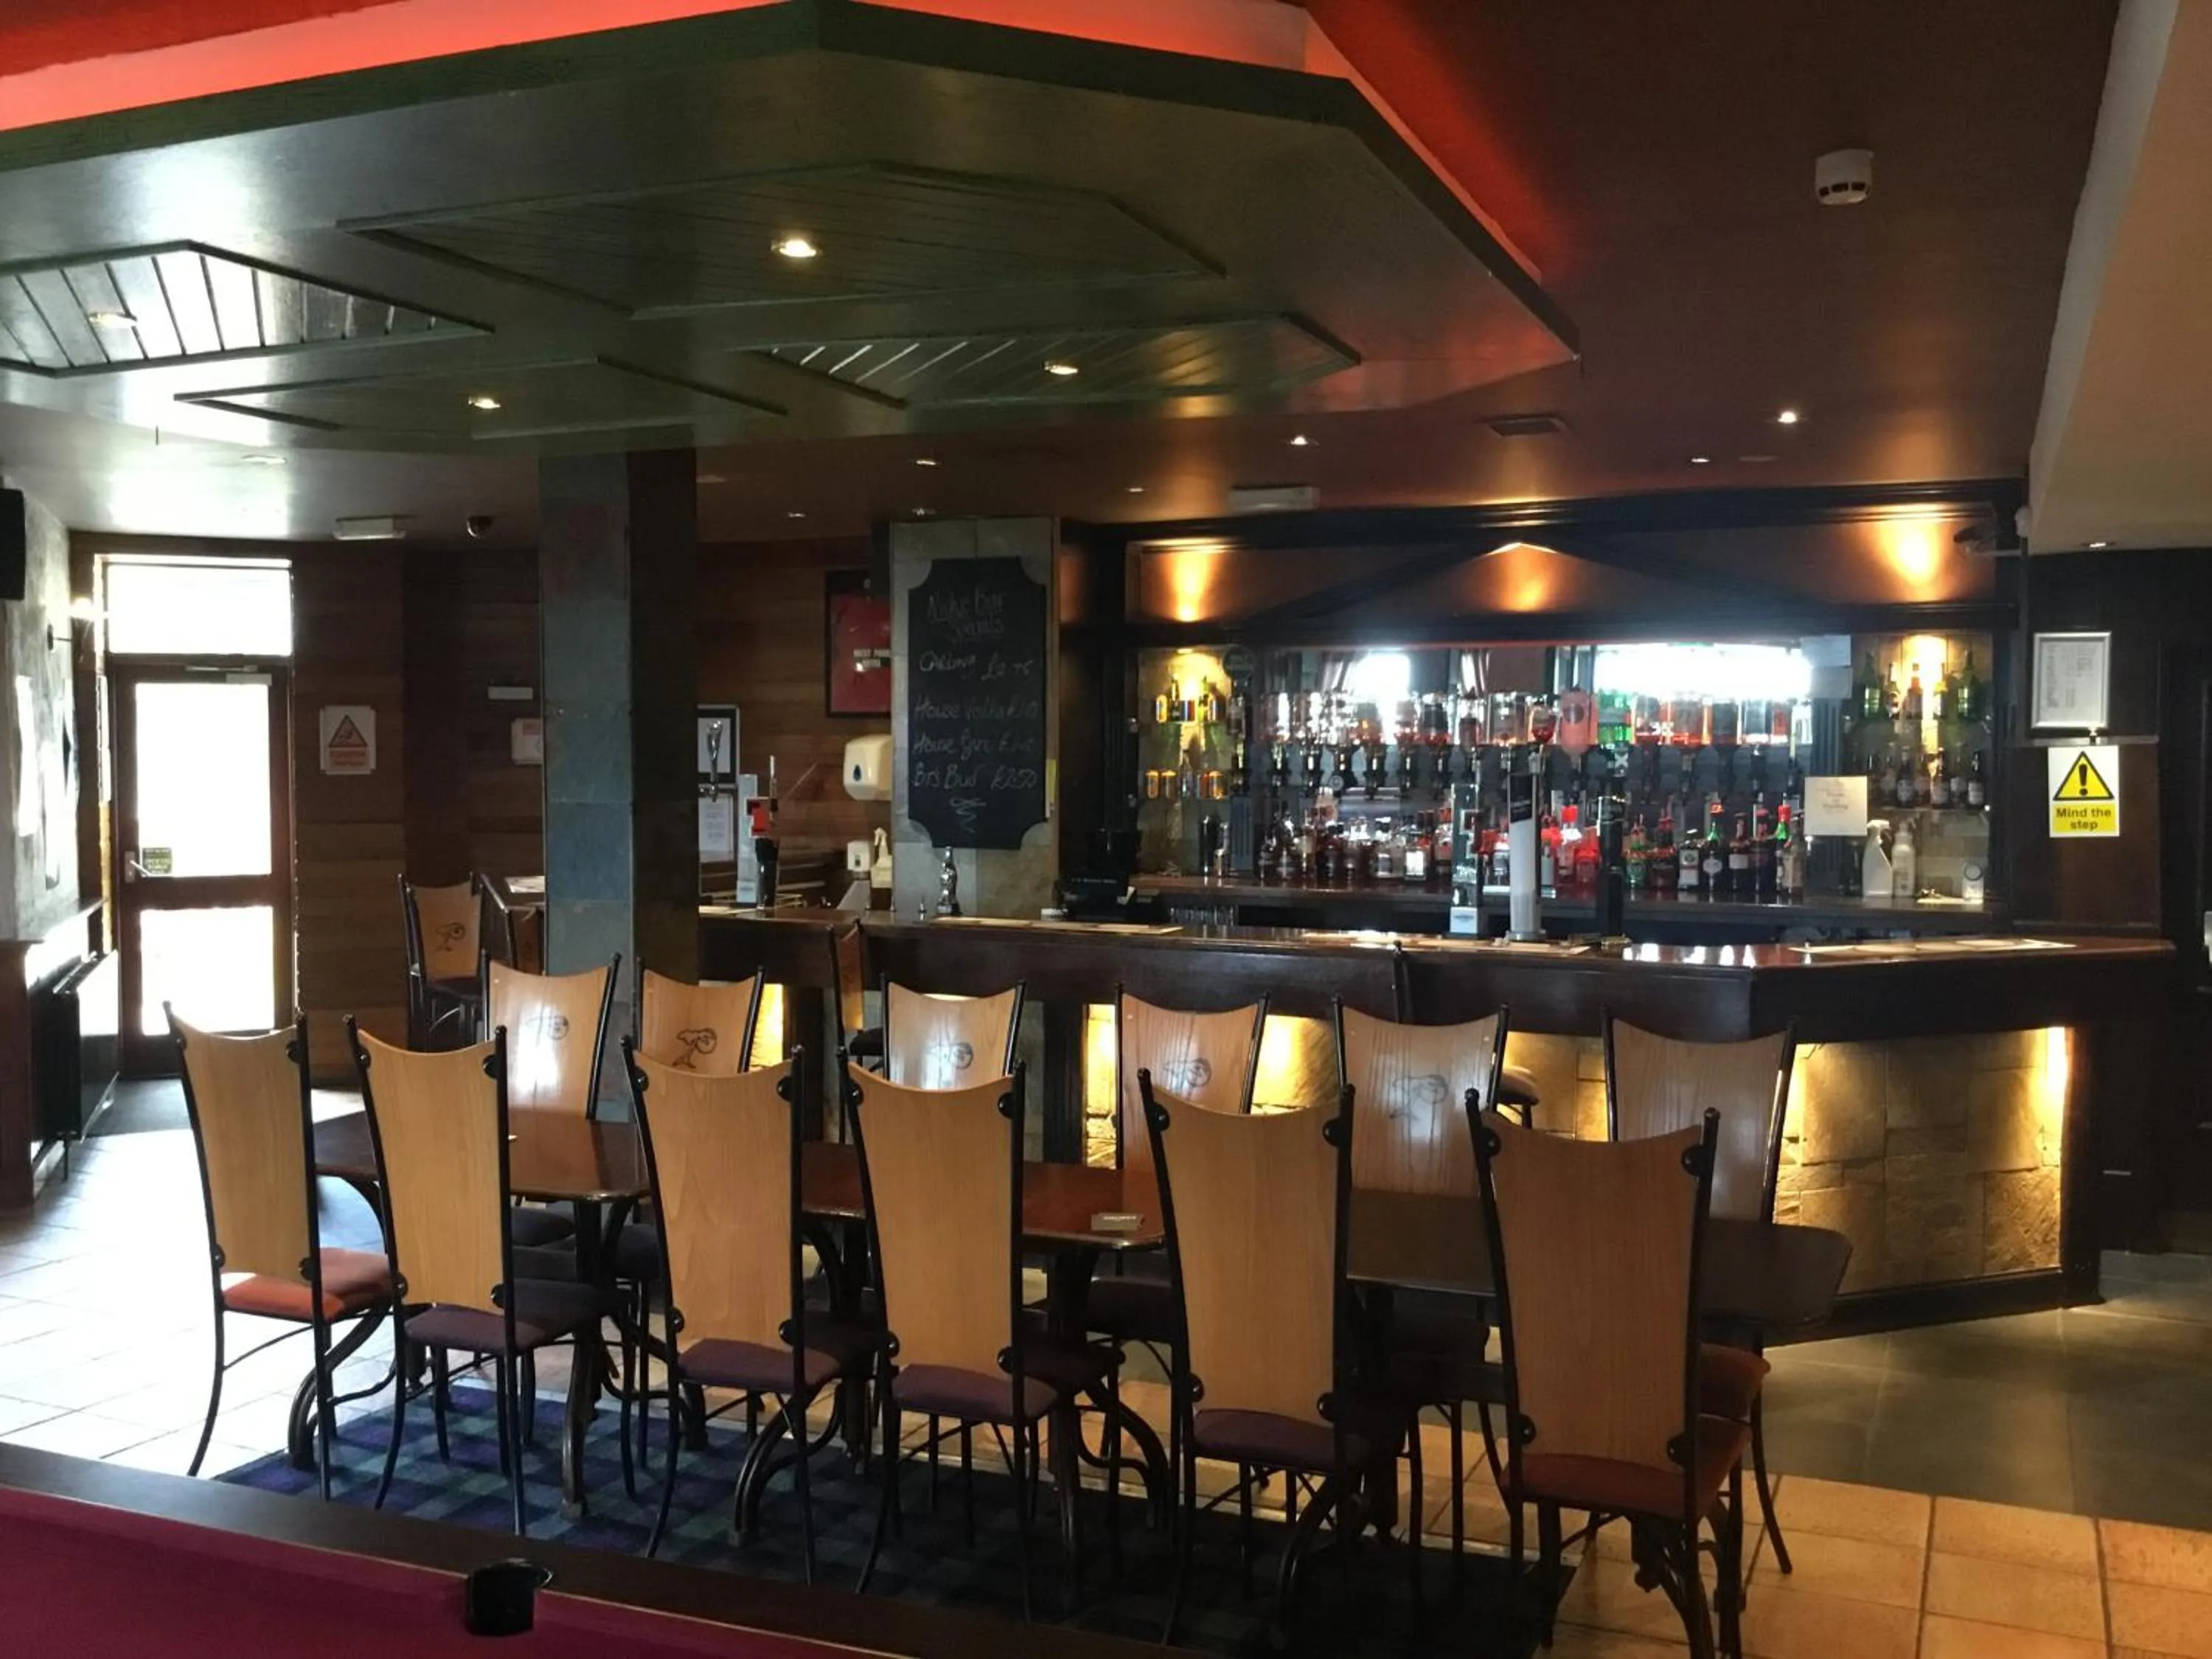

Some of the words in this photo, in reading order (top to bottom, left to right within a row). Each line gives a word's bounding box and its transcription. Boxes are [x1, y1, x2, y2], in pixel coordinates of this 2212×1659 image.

[2056, 807, 2087, 818] Mind
[2091, 807, 2111, 818] the
[2070, 820, 2098, 832] step
